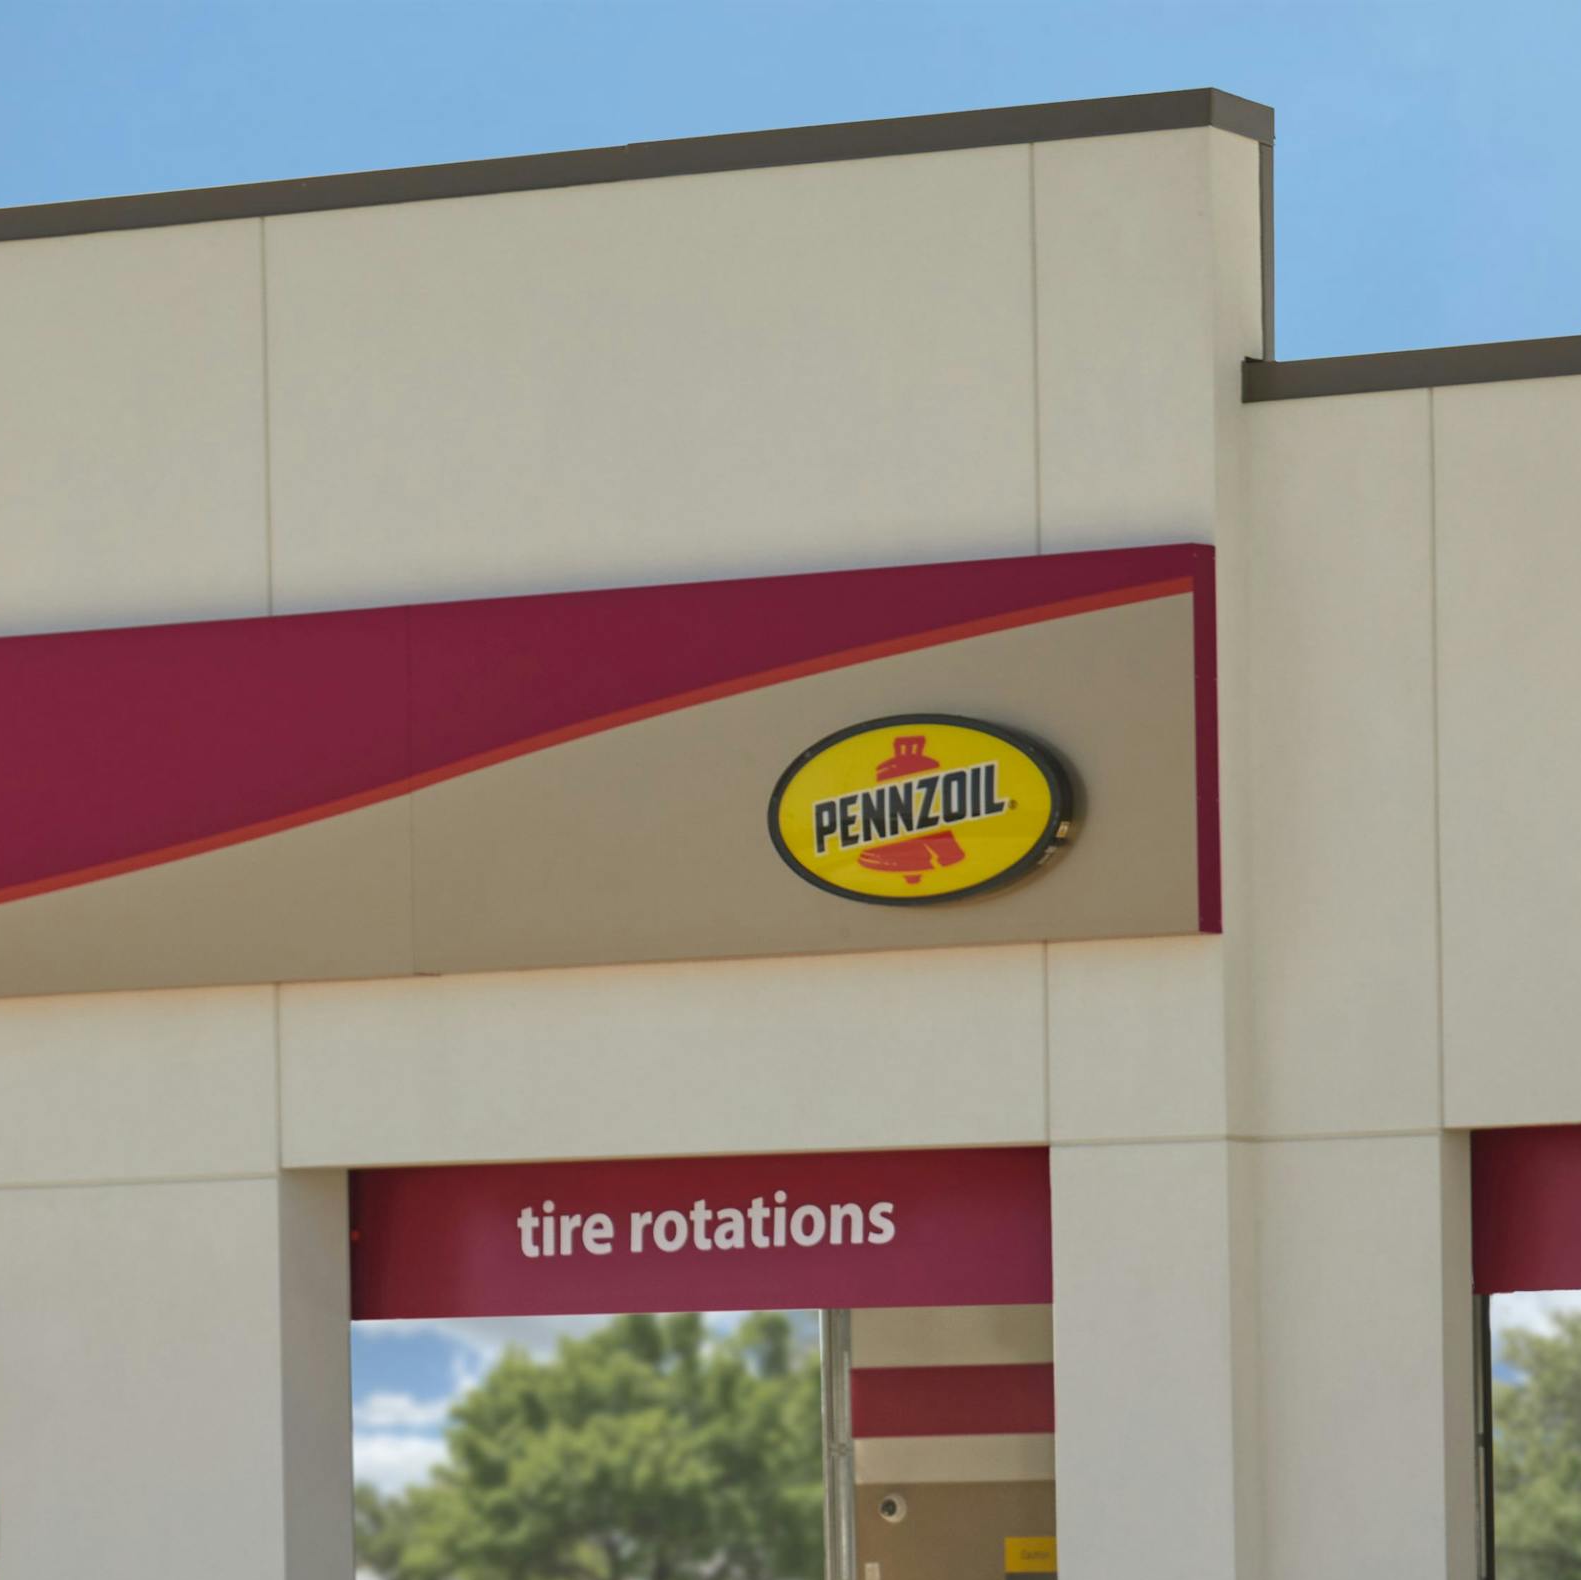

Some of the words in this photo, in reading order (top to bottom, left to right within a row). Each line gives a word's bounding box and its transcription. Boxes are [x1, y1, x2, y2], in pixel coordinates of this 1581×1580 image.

[813, 762, 1006, 855] PENNZOIL
[517, 1200, 615, 1259] tire
[629, 1190, 896, 1254] rotations
